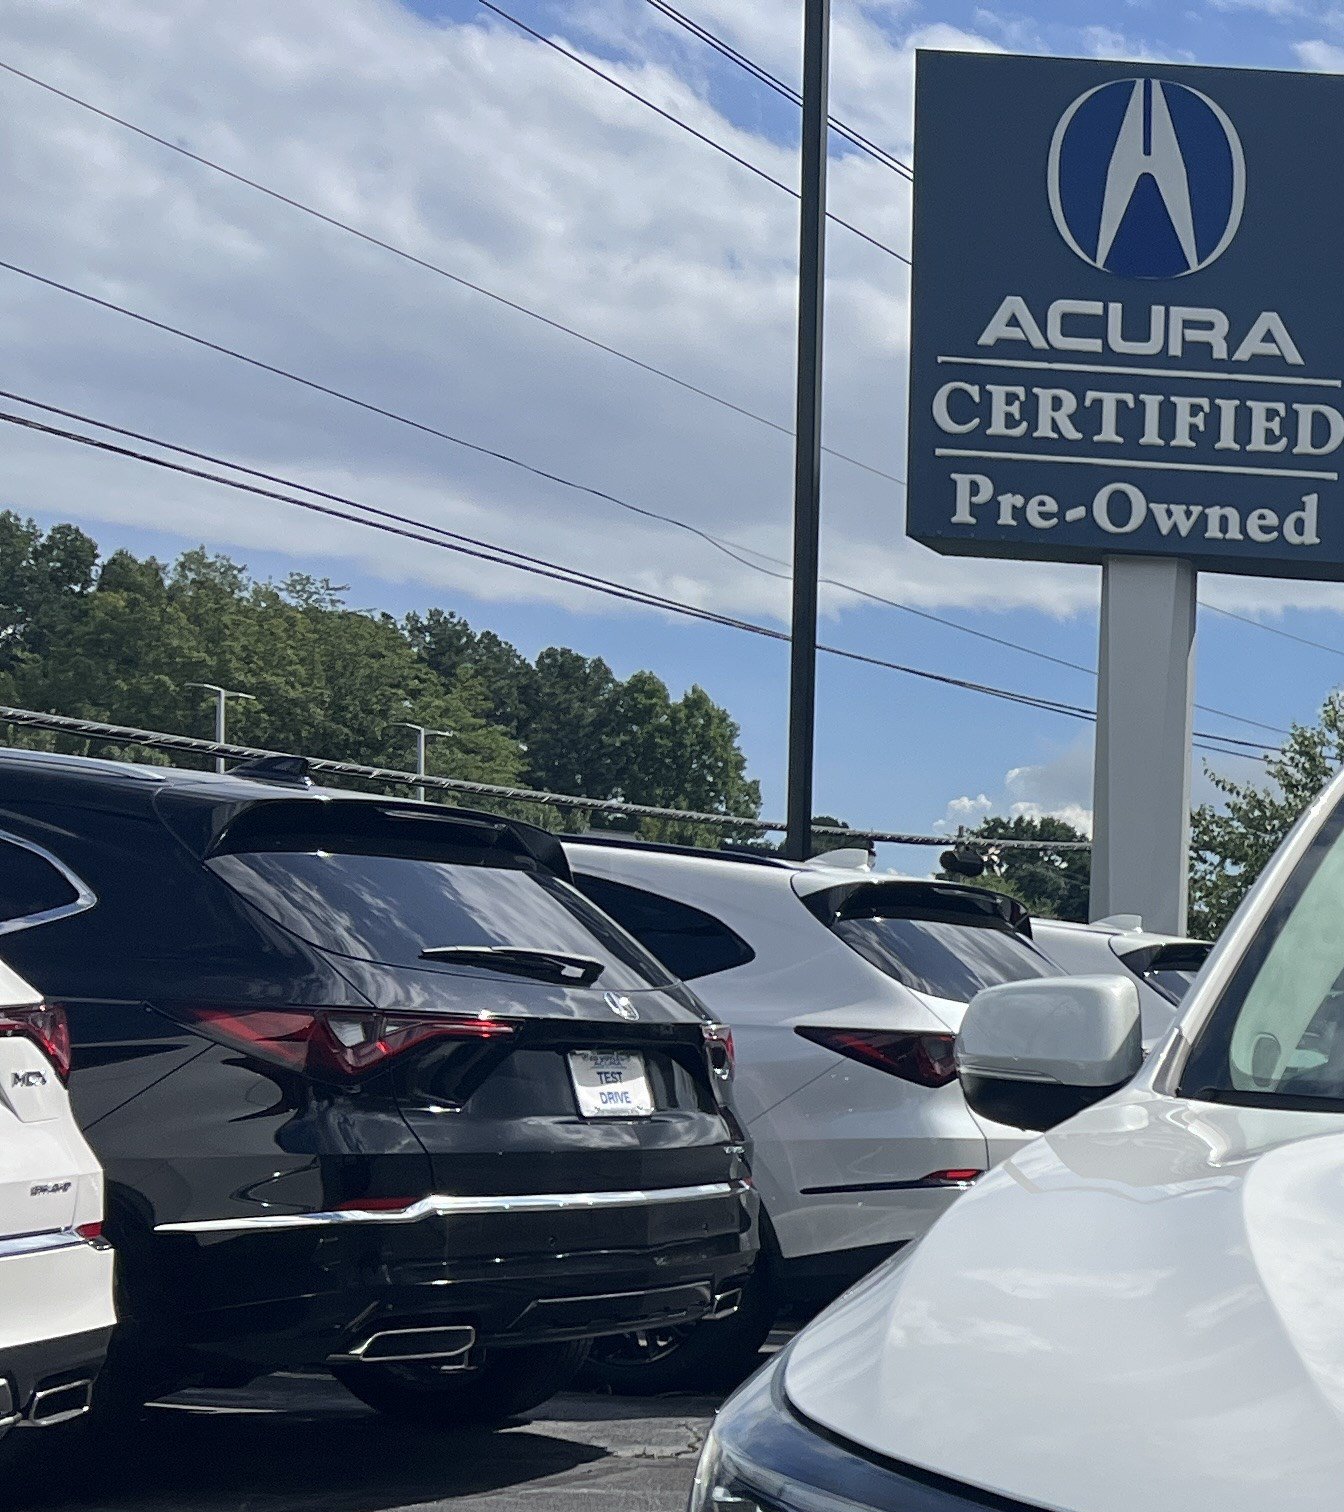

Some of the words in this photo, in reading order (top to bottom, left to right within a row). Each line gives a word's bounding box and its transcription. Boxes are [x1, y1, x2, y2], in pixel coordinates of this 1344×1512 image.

[976, 295, 1306, 366] ACURA
[949, 472, 1321, 547] Pre-Owned
[597, 1072, 622, 1084] TEST
[600, 1092, 632, 1104] DRIVE
